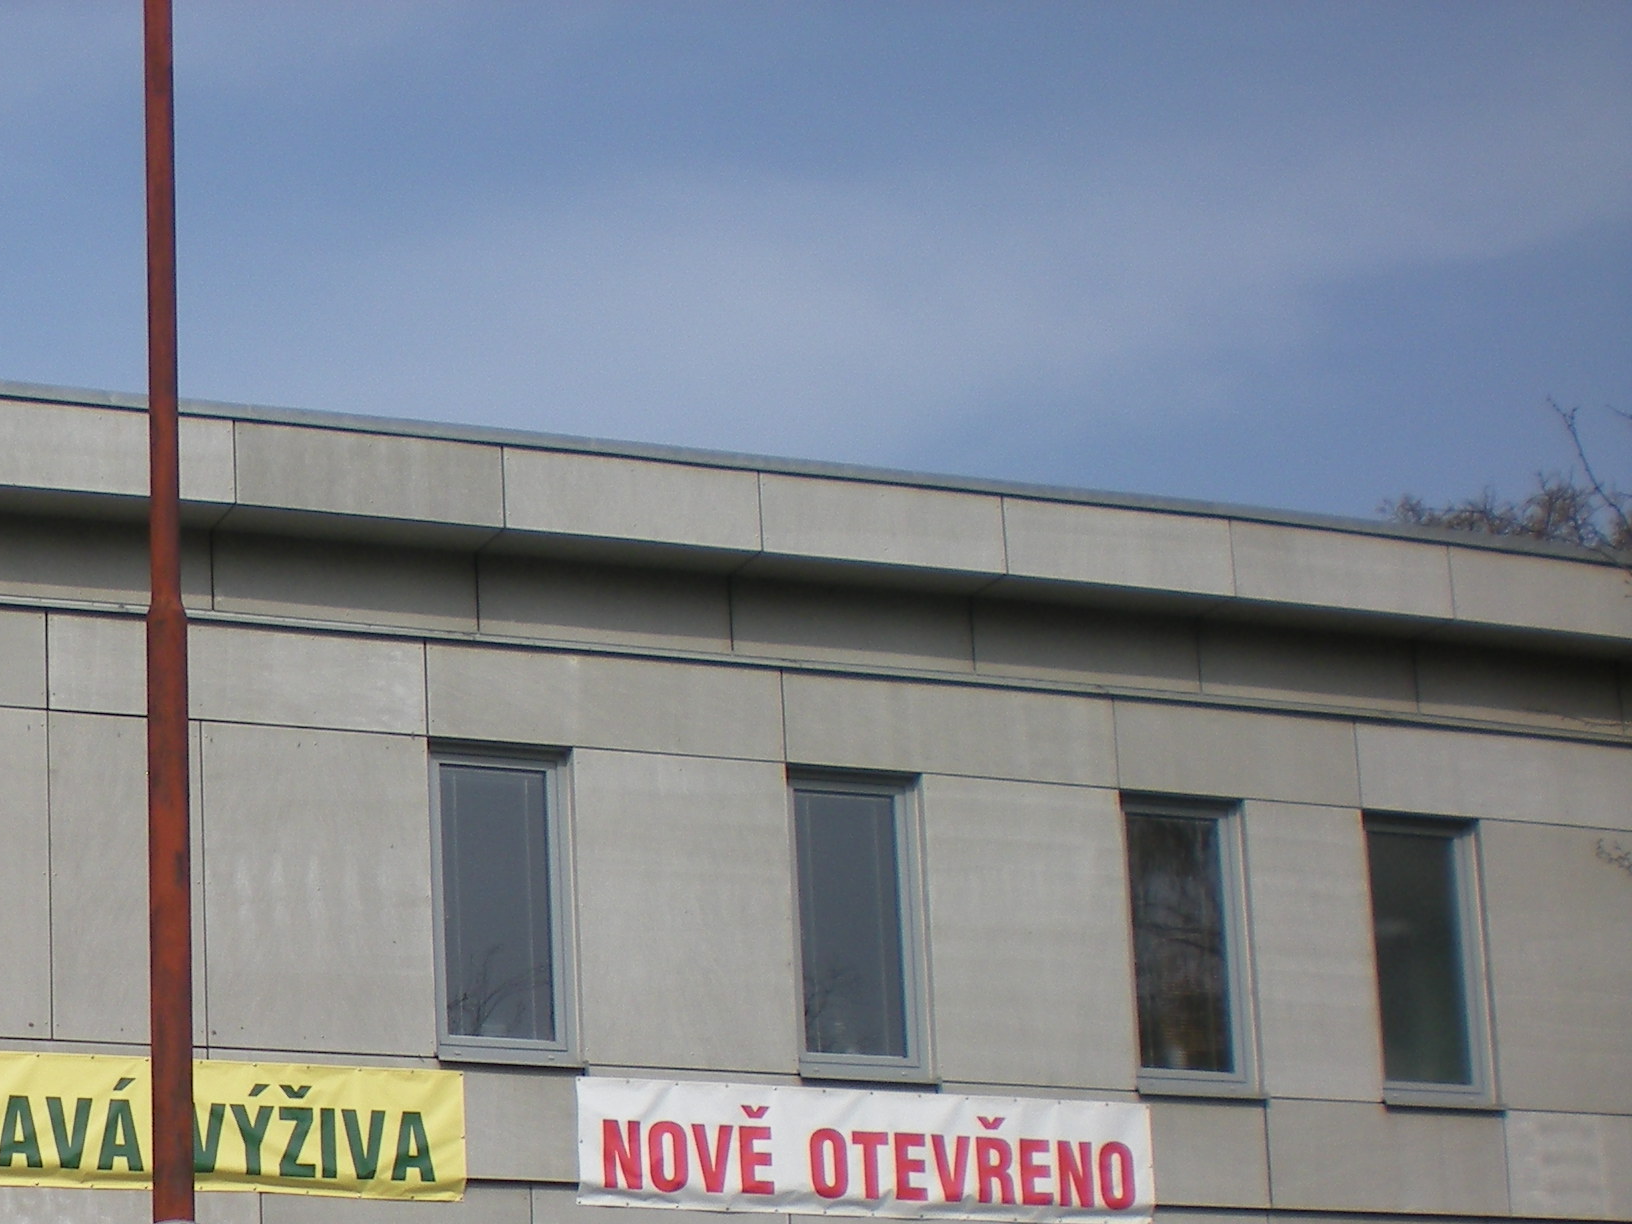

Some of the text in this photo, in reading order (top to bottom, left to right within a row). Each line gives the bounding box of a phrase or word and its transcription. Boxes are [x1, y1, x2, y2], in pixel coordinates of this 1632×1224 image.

[193, 1084, 436, 1183] VÝŽIVA
[601, 1104, 1136, 1211] NOVĚ OTEVŘENO
